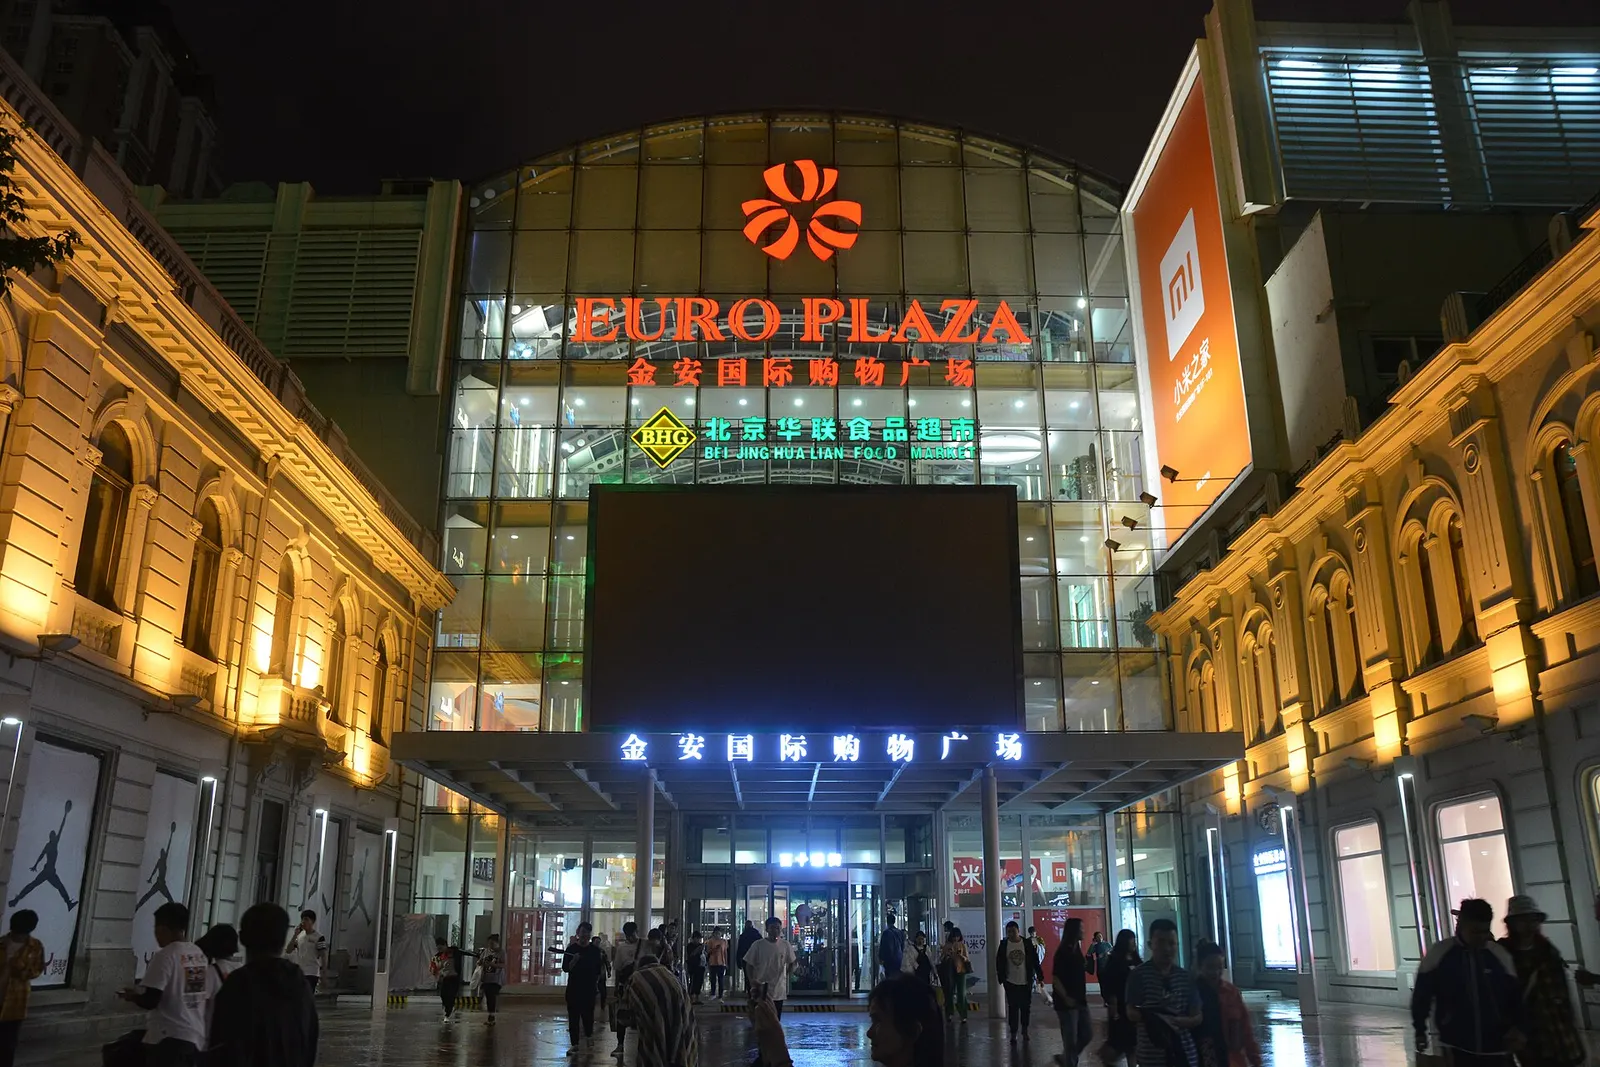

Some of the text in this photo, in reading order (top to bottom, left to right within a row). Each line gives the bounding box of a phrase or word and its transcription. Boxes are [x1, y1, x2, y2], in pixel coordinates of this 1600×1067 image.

[571, 298, 1032, 344] EURO PLAZA
[626, 357, 975, 387] 金安国际购物广场
[1173, 337, 1211, 405] 小米之家
[640, 428, 690, 446] BHG
[704, 415, 976, 442] 北京华联食品超市
[704, 445, 977, 460] BEI JING HUA LIAN FOOD MARKET
[620, 732, 1023, 762] 金安国际购物广场
